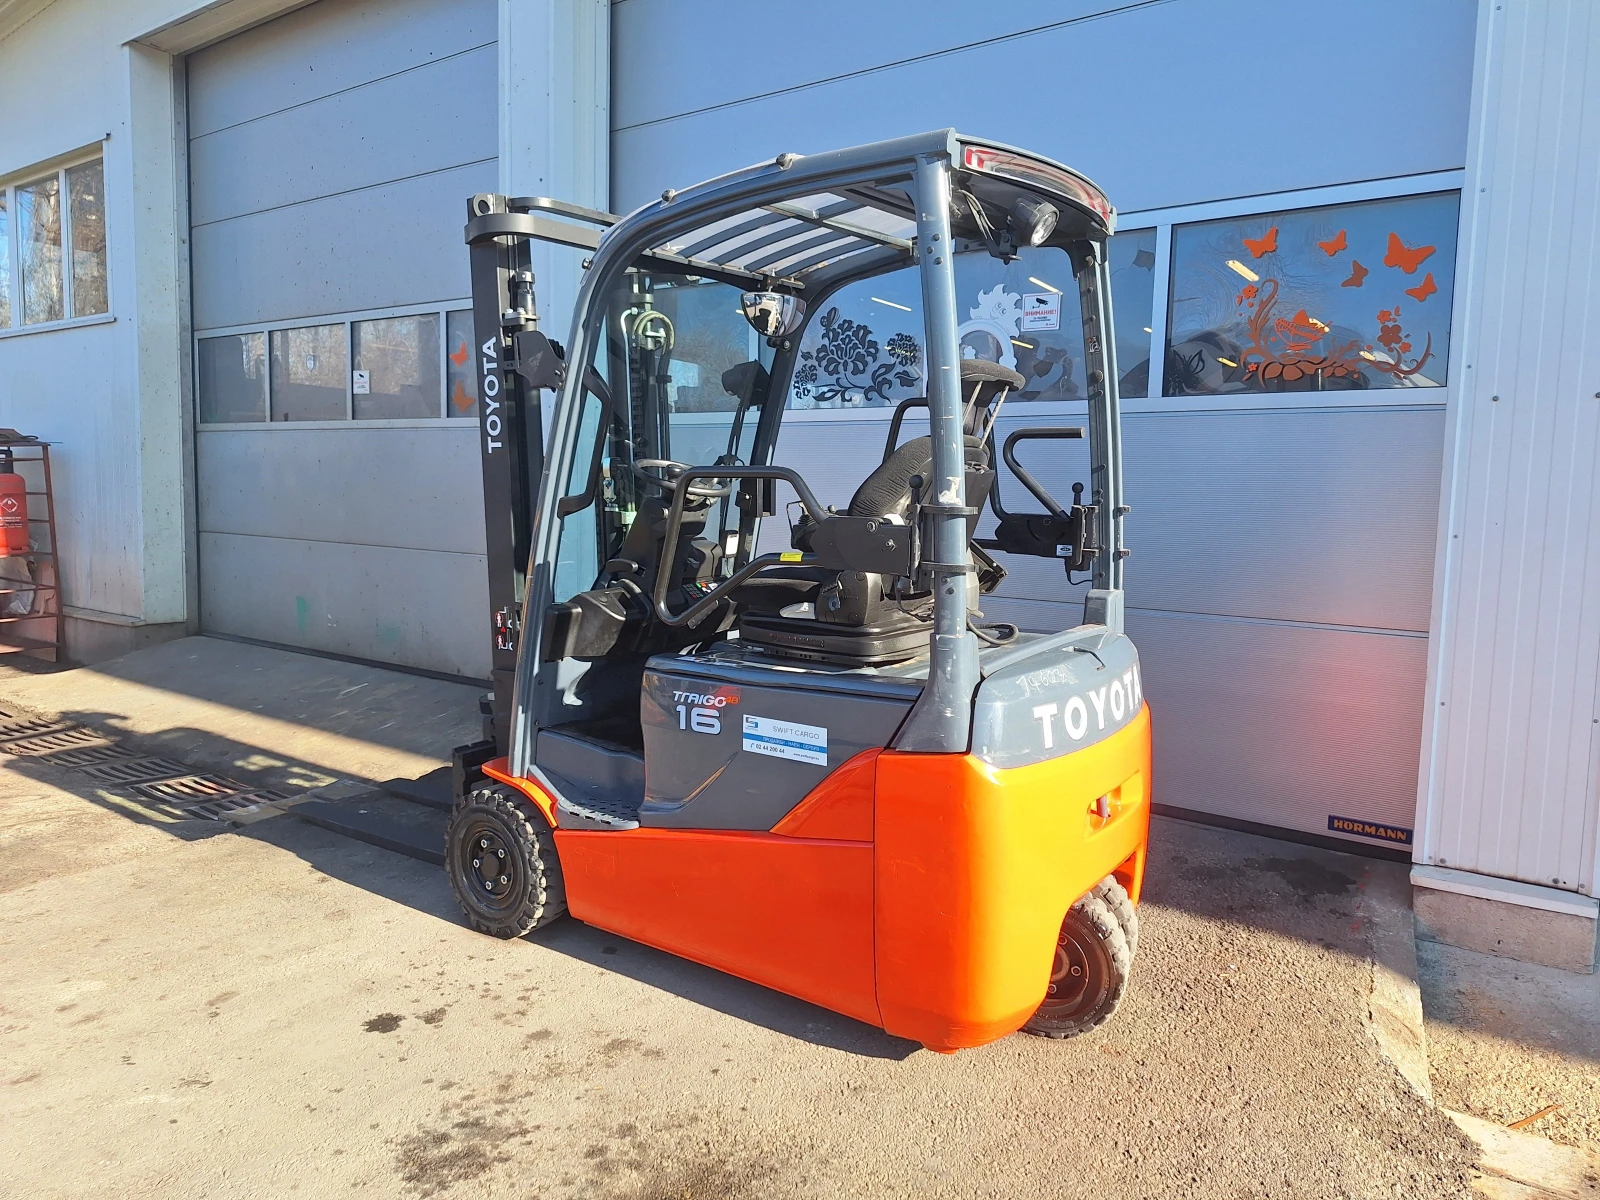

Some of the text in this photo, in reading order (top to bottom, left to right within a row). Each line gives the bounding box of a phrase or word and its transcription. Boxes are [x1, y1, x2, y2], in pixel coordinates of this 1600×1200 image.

[1025, 309, 1057, 317] ВНИМАНИЕ!
[482, 336, 502, 454] TOYOTA
[676, 704, 721, 735] 16
[1032, 663, 1141, 750] TOYOTA
[772, 725, 820, 740] SWIFT CARGO
